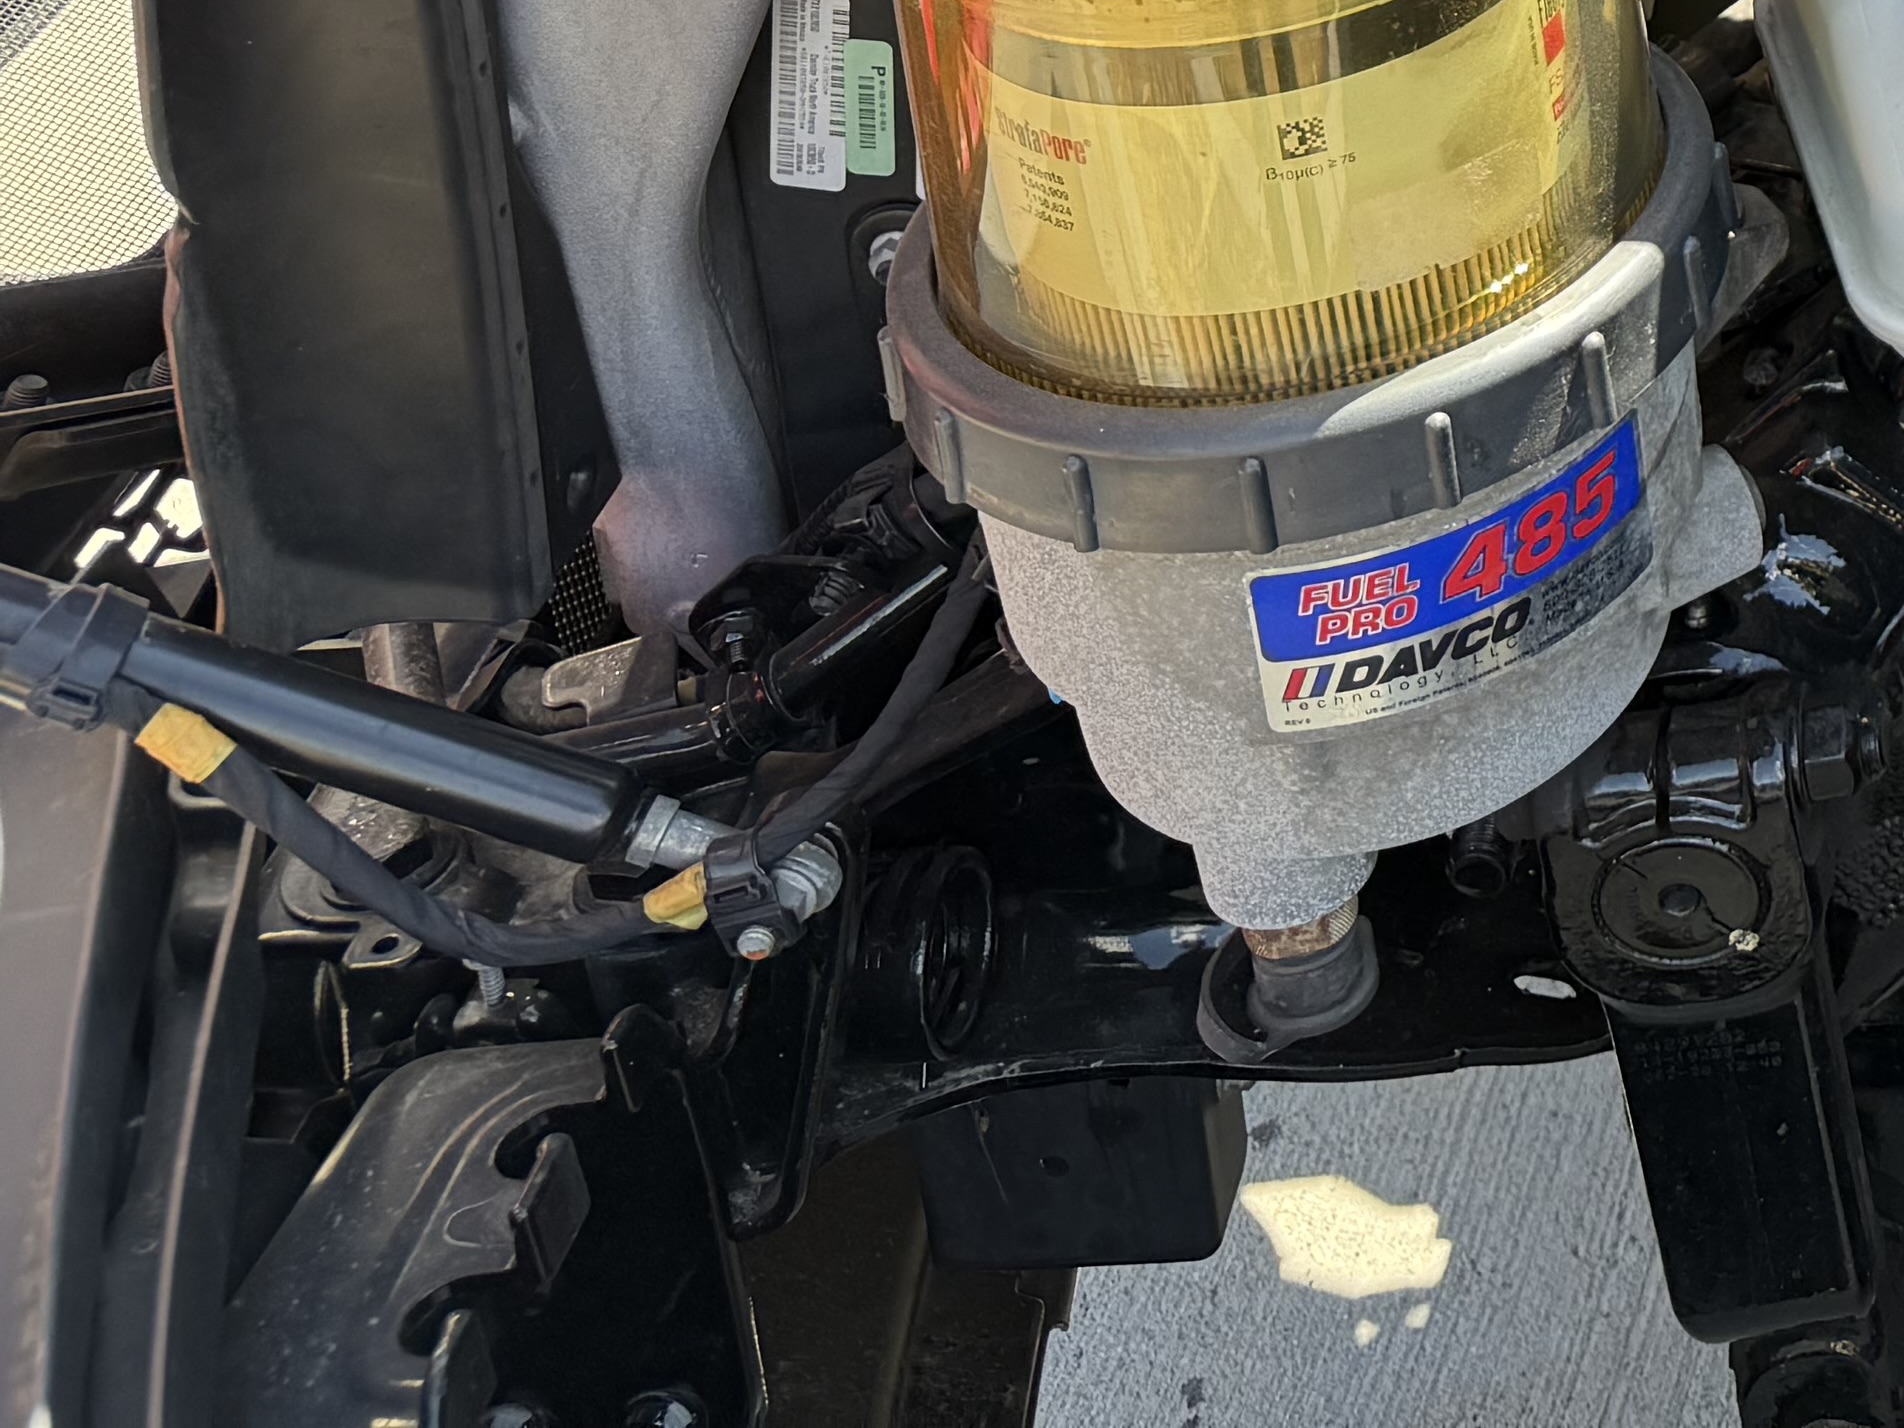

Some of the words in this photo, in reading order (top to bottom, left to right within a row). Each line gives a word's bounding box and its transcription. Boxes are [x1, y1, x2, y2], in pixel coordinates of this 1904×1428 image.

[1018, 157, 1065, 186] Patents
[1298, 562, 1421, 616] FUEL
[1439, 448, 1618, 605] 485
[1315, 595, 1419, 646] PRO
[1335, 597, 1532, 694] DAVCO
[1284, 718, 1302, 727] REV
[1381, 702, 1397, 714] and
